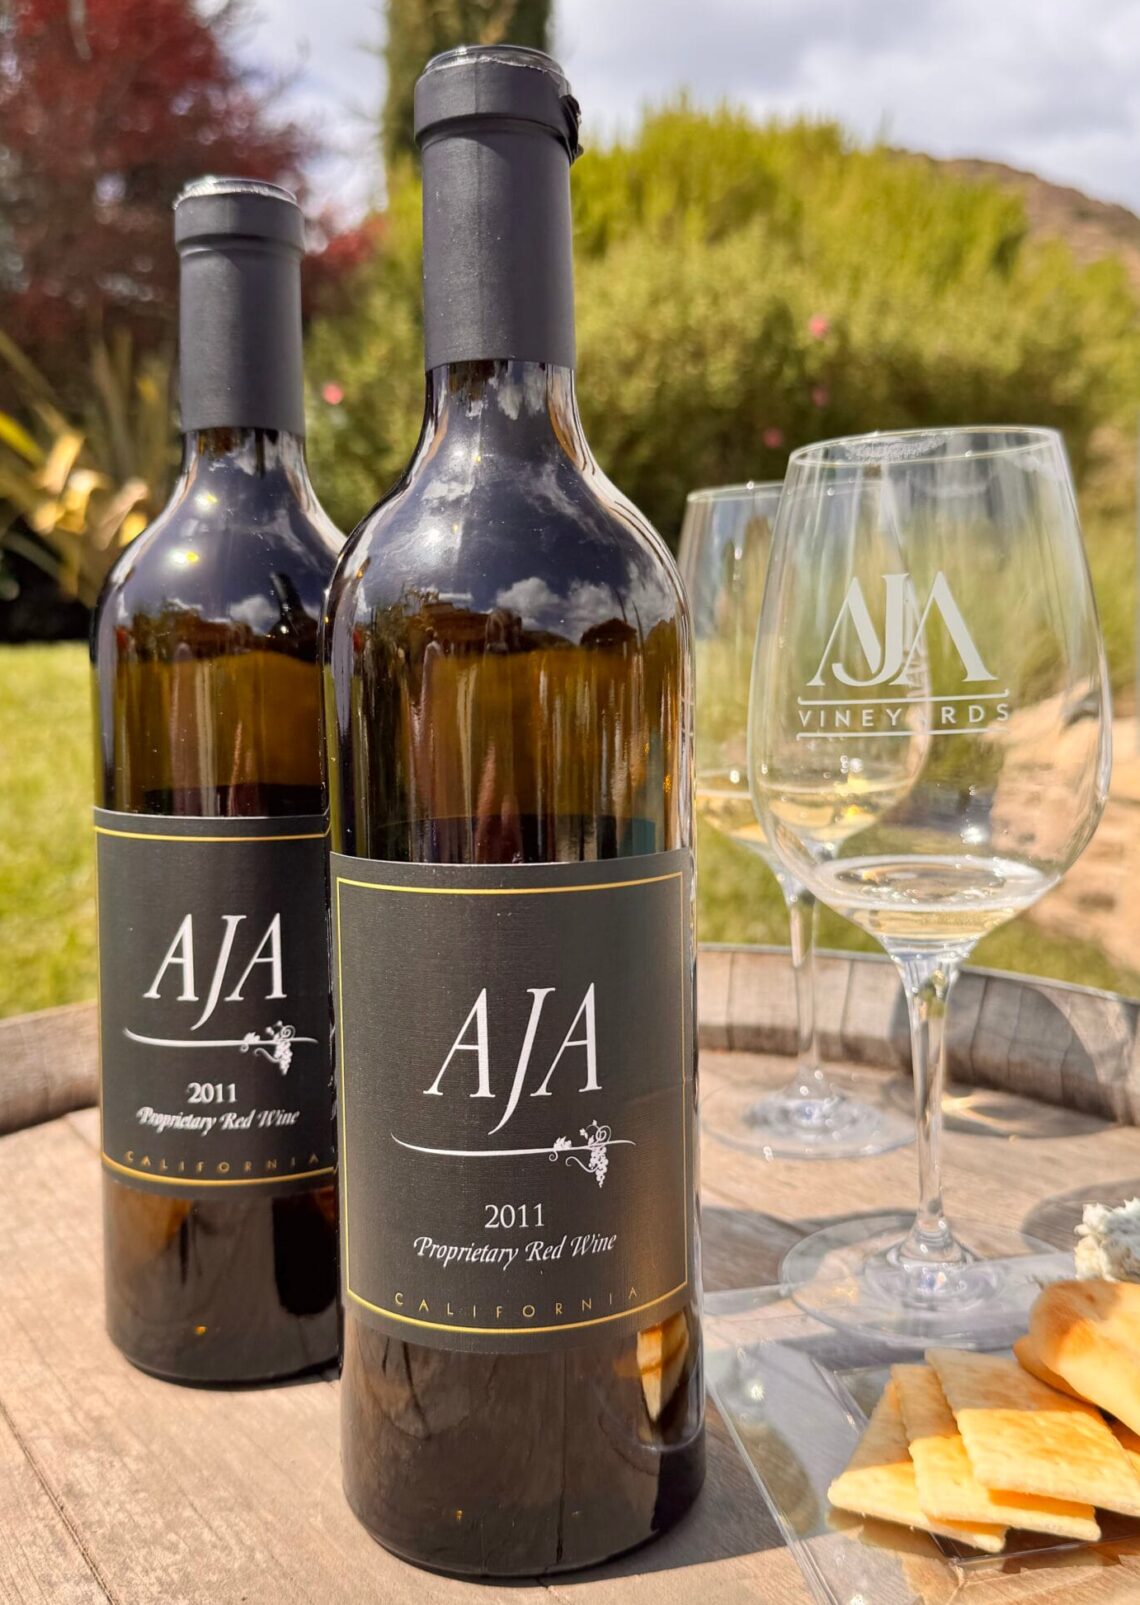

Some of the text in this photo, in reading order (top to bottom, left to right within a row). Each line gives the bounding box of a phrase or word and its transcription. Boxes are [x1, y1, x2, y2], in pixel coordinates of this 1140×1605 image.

[806, 571, 998, 687] AJA
[798, 704, 1009, 728] VINEYRDS
[142, 913, 287, 1031] AJA
[423, 982, 602, 1135] AJA
[187, 1082, 237, 1104] 2011
[136, 1106, 300, 1136] Proprietary Red Wine
[123, 1151, 320, 1173] CALIFORNIA
[485, 1203, 545, 1229] 2011
[413, 1234, 617, 1271] Proprietary Red Wine
[395, 1287, 639, 1318] CALIFORNIA
